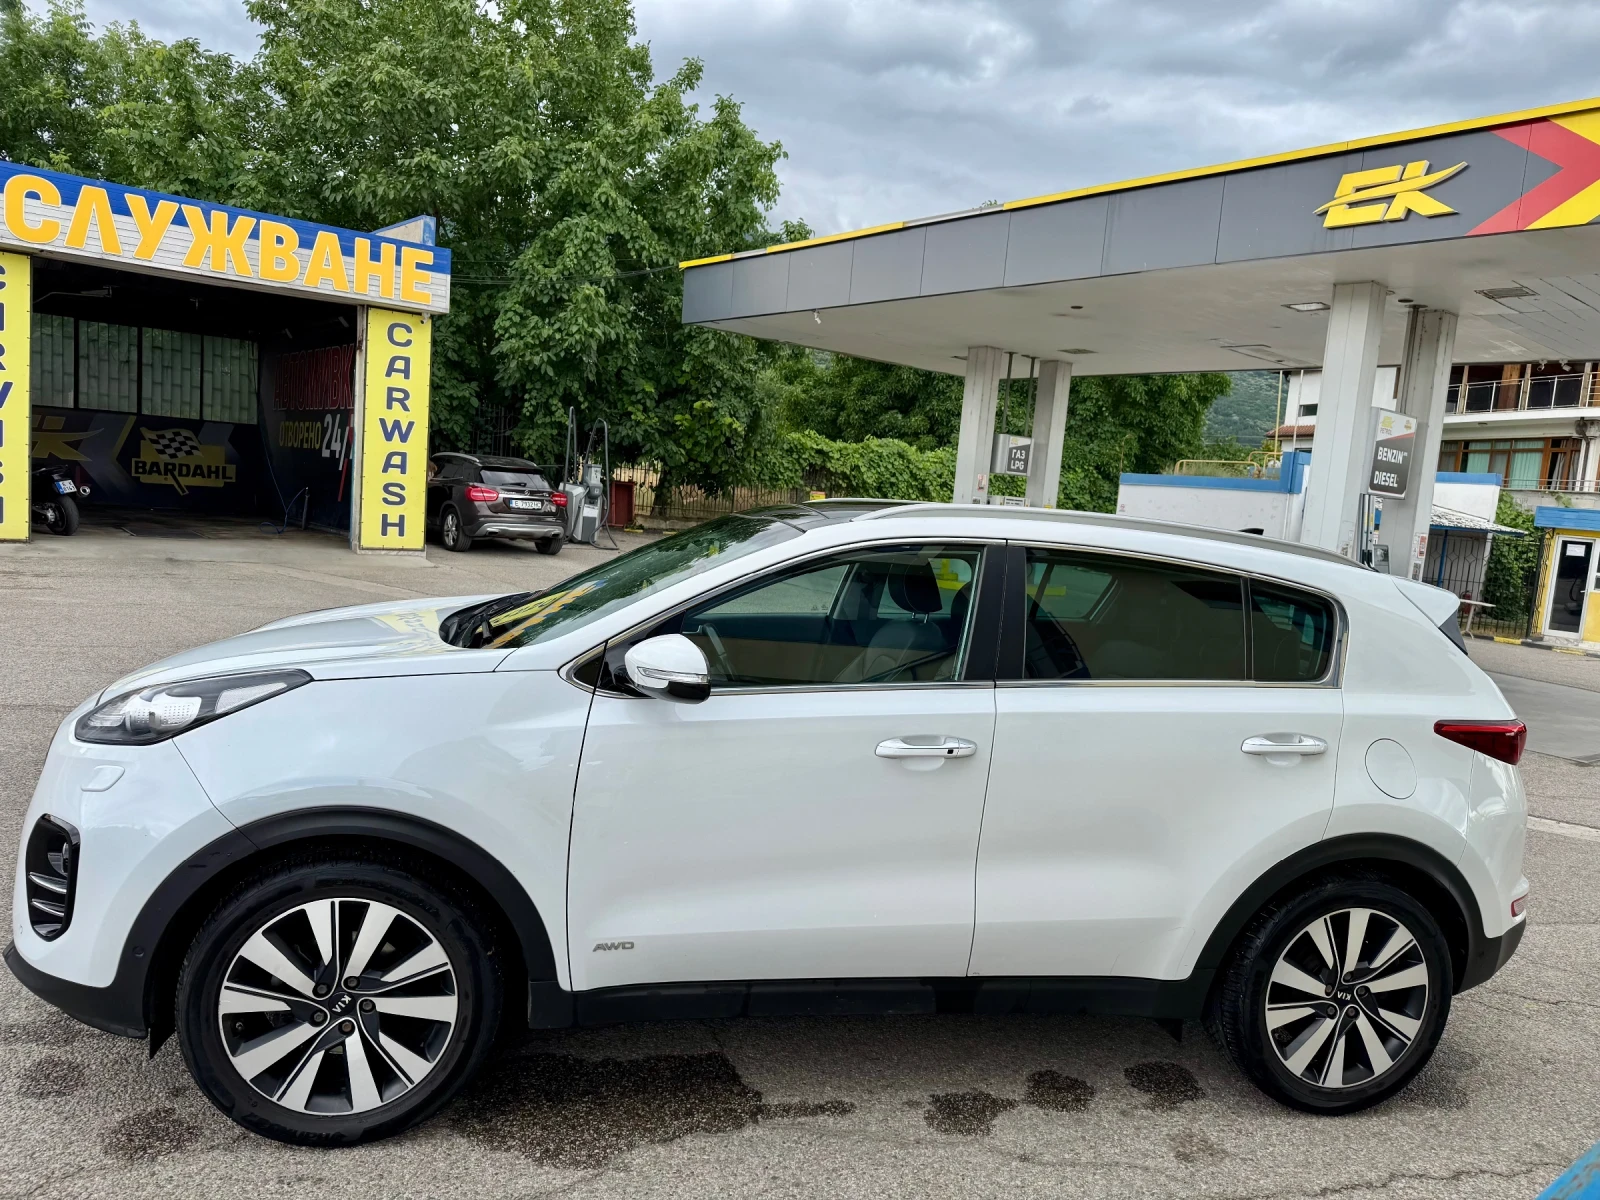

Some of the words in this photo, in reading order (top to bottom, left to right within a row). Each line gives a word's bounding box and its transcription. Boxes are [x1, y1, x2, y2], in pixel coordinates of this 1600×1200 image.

[4, 174, 435, 305] СЛУЖВАНЕ
[273, 343, 354, 411] АВТОМИВК
[279, 421, 322, 450] ОТВОРЕНО
[378, 322, 415, 538] CARWASH
[1011, 449, 1026, 460] ГАЗ
[134, 460, 234, 481] BARDAHL
[1010, 460, 1025, 470] LPG
[1373, 470, 1398, 488] DIESEL
[592, 941, 635, 952] AWD
[332, 994, 352, 1013] KIA
[1337, 991, 1352, 1001] KIA
